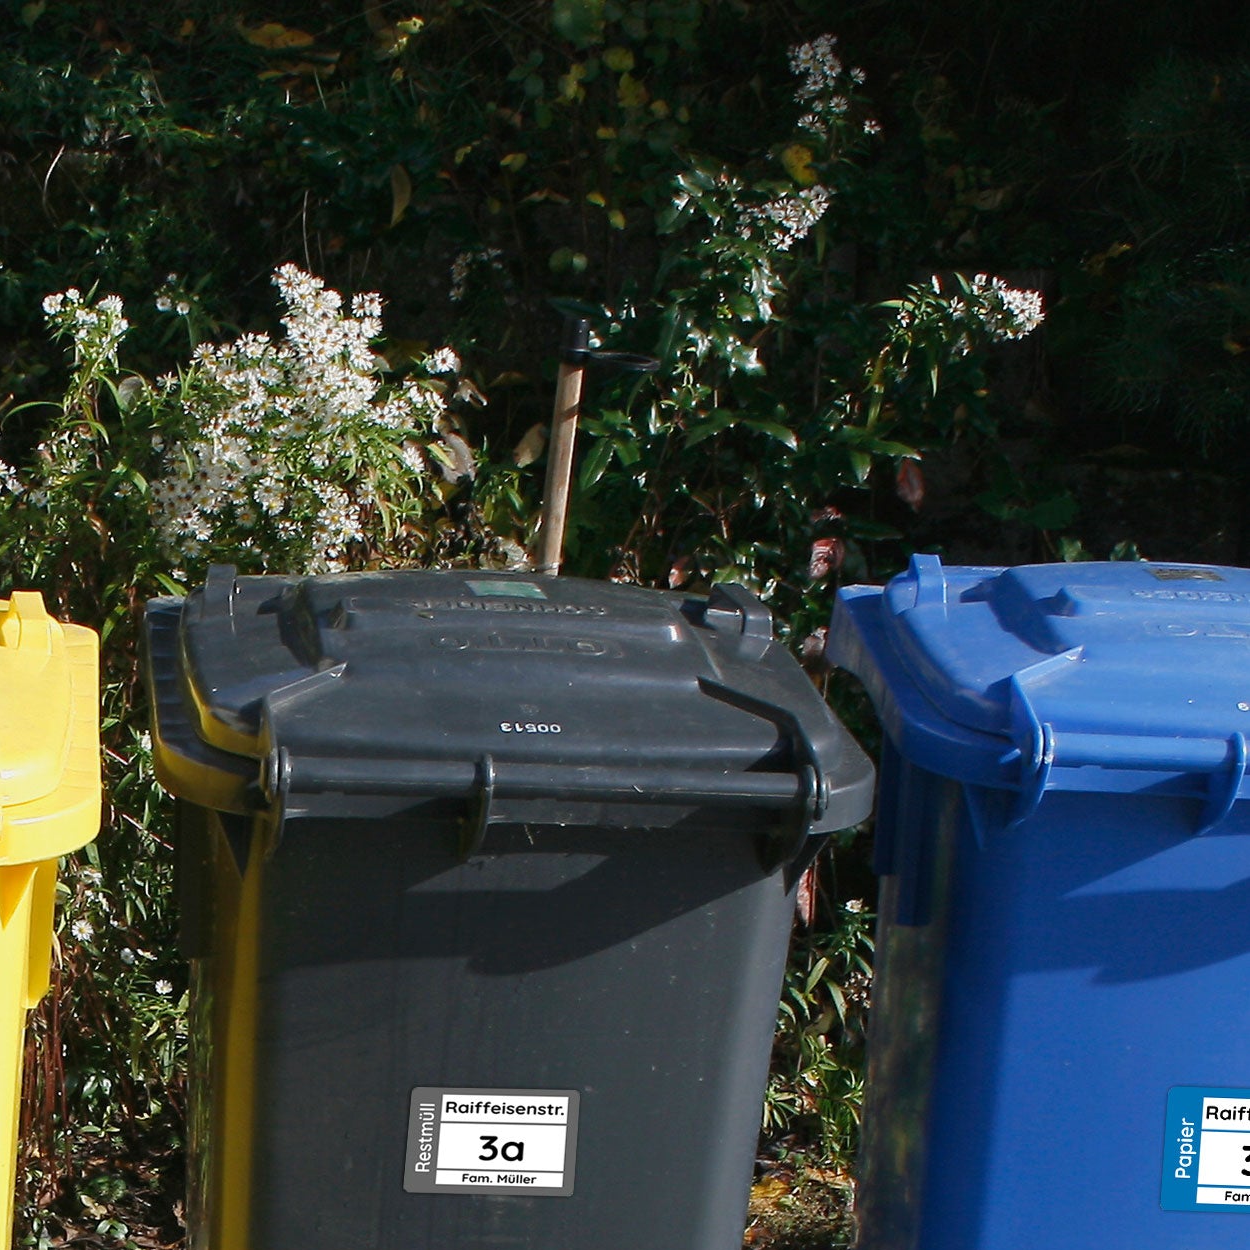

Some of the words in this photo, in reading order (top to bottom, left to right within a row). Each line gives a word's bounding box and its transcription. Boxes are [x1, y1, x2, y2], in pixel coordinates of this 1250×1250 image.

[500, 722, 562, 733] 00513
[445, 1101, 565, 1116] Raiffeisenstr.
[414, 1103, 436, 1173] Restmüll
[478, 1135, 525, 1162] 3a
[1174, 1117, 1197, 1179] Papier
[461, 1173, 493, 1183] Fam.
[497, 1174, 537, 1185] Müller
